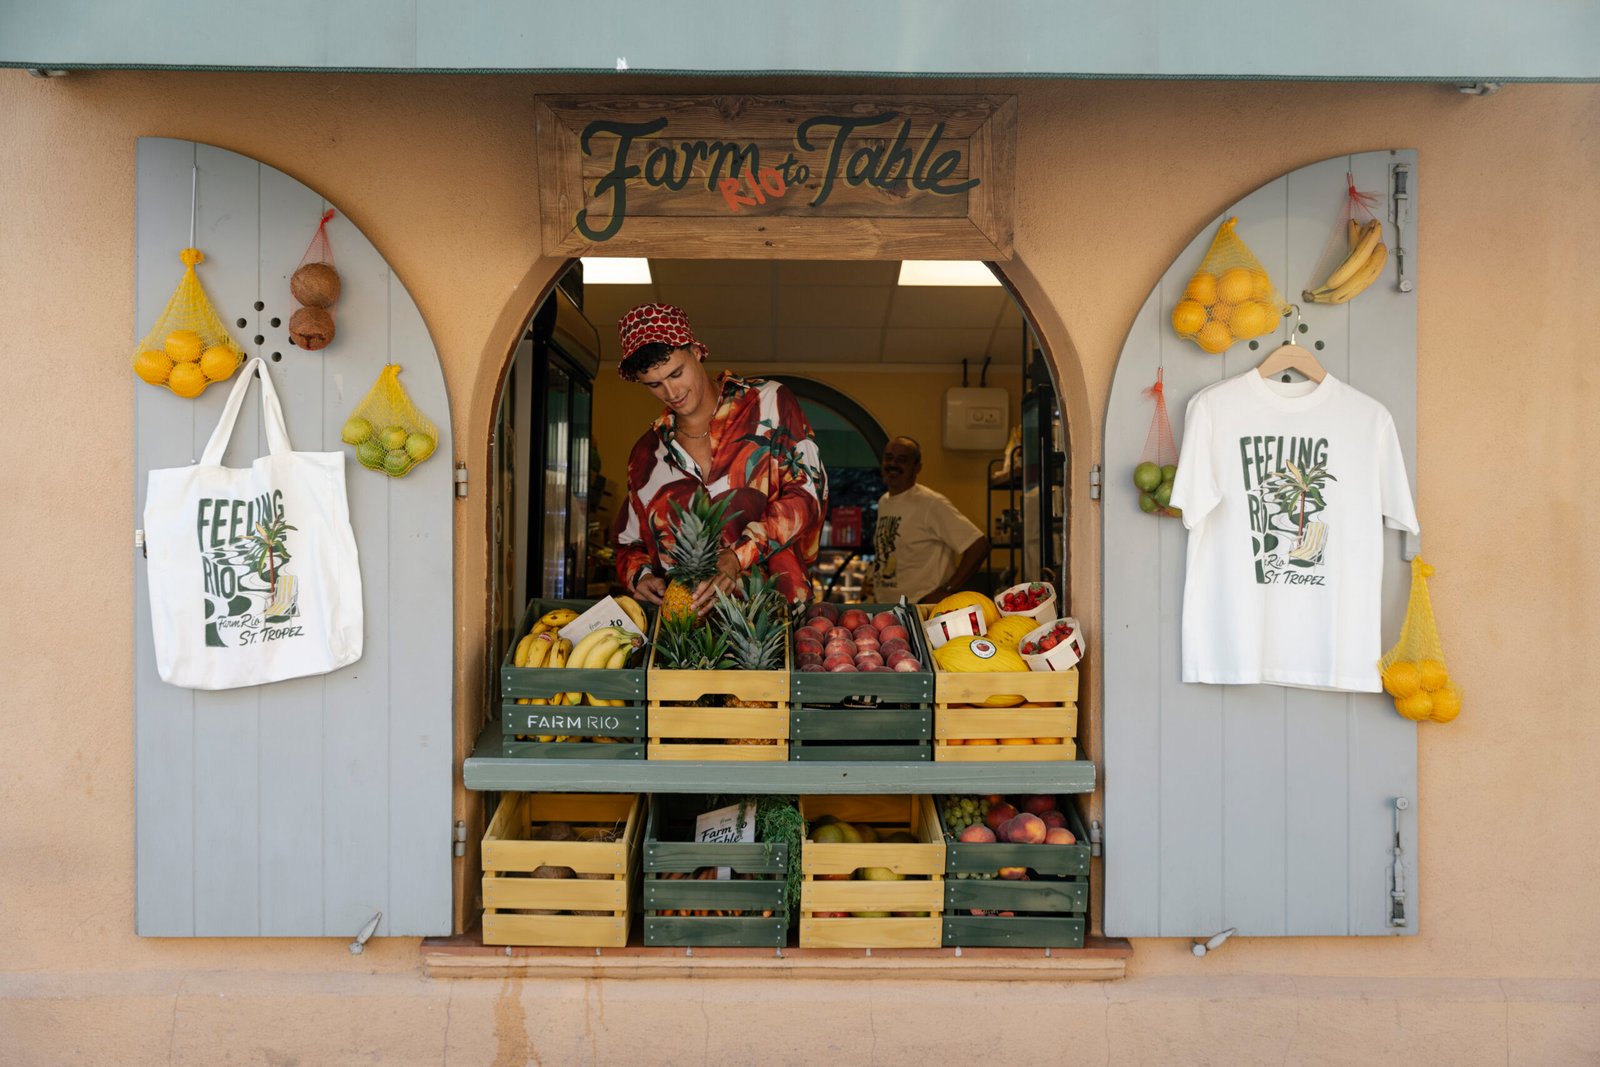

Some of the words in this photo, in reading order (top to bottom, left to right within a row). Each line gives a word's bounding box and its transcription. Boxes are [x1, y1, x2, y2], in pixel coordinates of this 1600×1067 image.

[576, 116, 761, 241] Farm
[778, 152, 809, 187] to
[793, 111, 981, 207] Table
[719, 166, 788, 213] RIO
[1239, 435, 1329, 491] FEELING
[197, 489, 285, 553] FEELING
[202, 555, 236, 600] RIO
[1283, 570, 1326, 586] TROPEZ
[217, 617, 241, 631] Farm
[239, 613, 263, 629] Rio
[260, 625, 305, 642] TROPEZ
[527, 715, 582, 729] FARM
[587, 716, 619, 730] RIO
[701, 826, 732, 843] Farm
